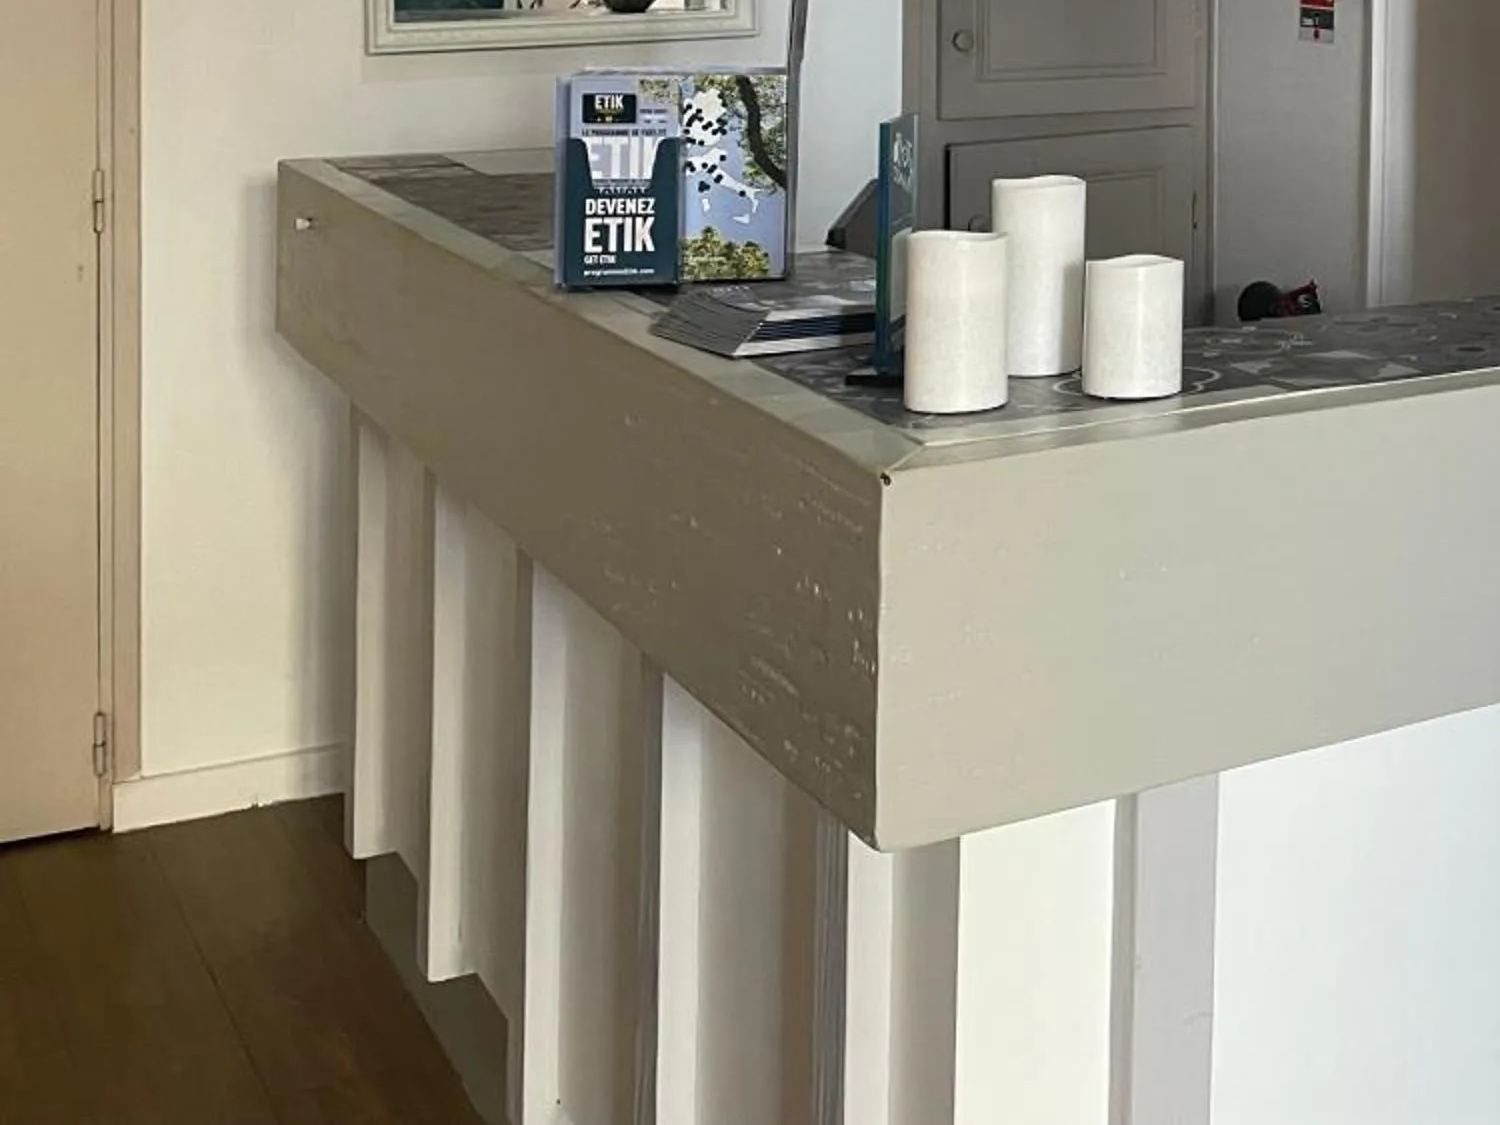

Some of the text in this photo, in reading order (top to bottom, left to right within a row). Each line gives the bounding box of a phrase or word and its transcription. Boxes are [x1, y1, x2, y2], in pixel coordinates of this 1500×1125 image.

[594, 94, 625, 110] ETIK
[585, 198, 656, 215] DEVENEZ
[584, 217, 655, 253] ETIK
